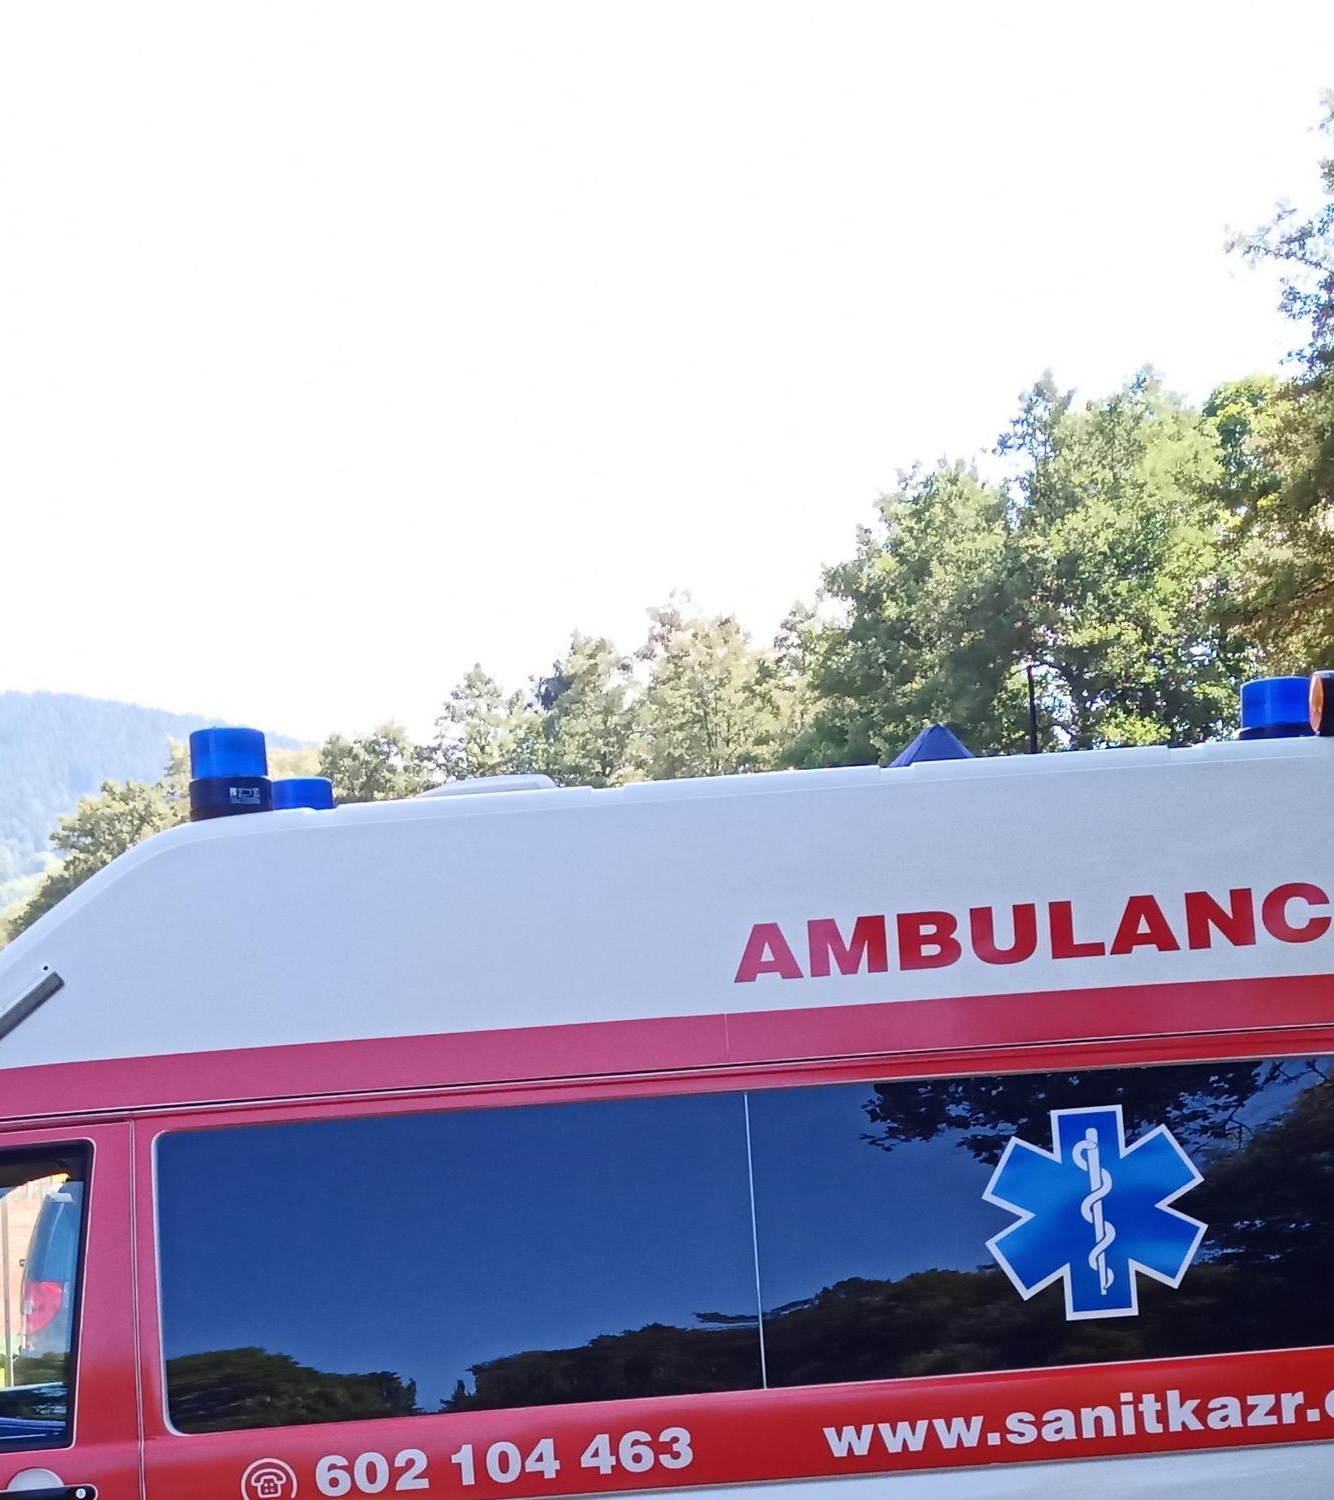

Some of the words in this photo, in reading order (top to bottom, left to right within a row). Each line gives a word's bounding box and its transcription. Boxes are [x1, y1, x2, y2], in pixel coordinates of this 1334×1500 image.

[315, 1449, 429, 1497] 602
[451, 1438, 560, 1485] 104
[580, 1427, 694, 1475] 463
